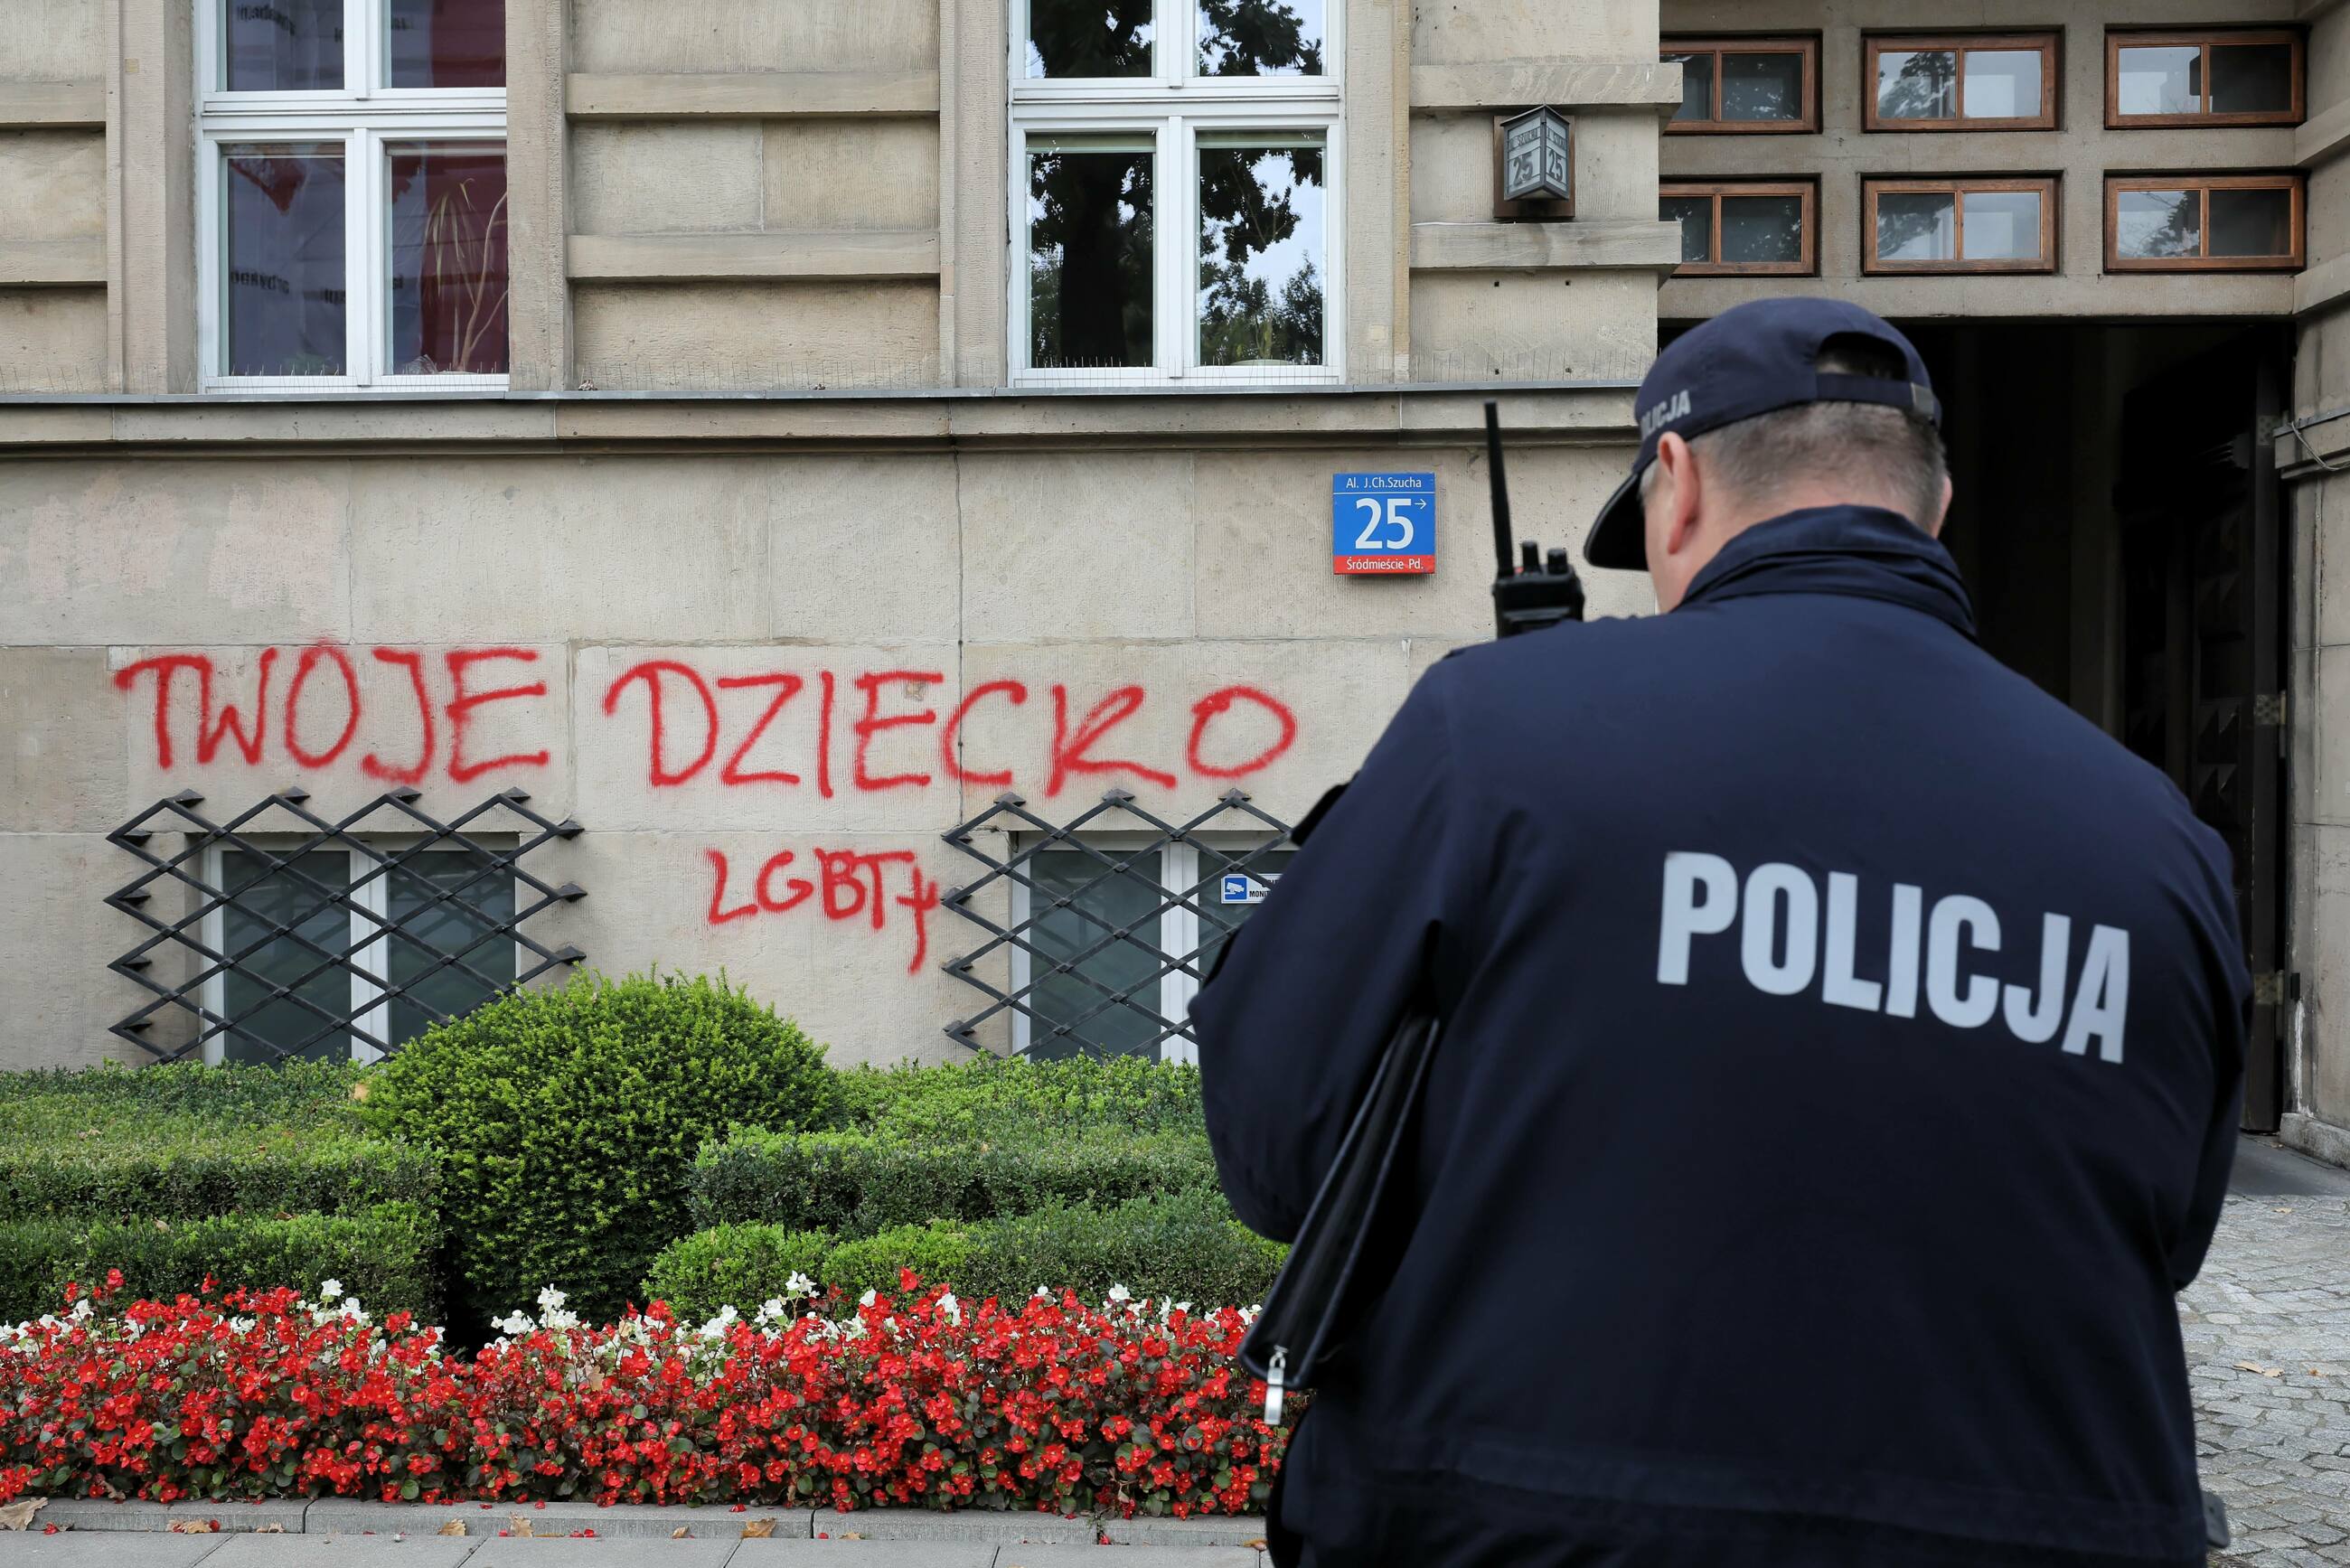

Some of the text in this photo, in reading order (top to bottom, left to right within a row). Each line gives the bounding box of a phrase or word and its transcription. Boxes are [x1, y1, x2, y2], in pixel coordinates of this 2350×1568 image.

[1513, 152, 1534, 186] 25
[1549, 149, 1564, 183] 25
[1346, 476, 1359, 488] Al.
[1355, 498, 1414, 549] 25
[1346, 557, 1424, 569] Śródmieście Pd.
[114, 638, 1297, 797] TWOJE DZIECKO
[1657, 850, 2130, 1065] POLICJA
